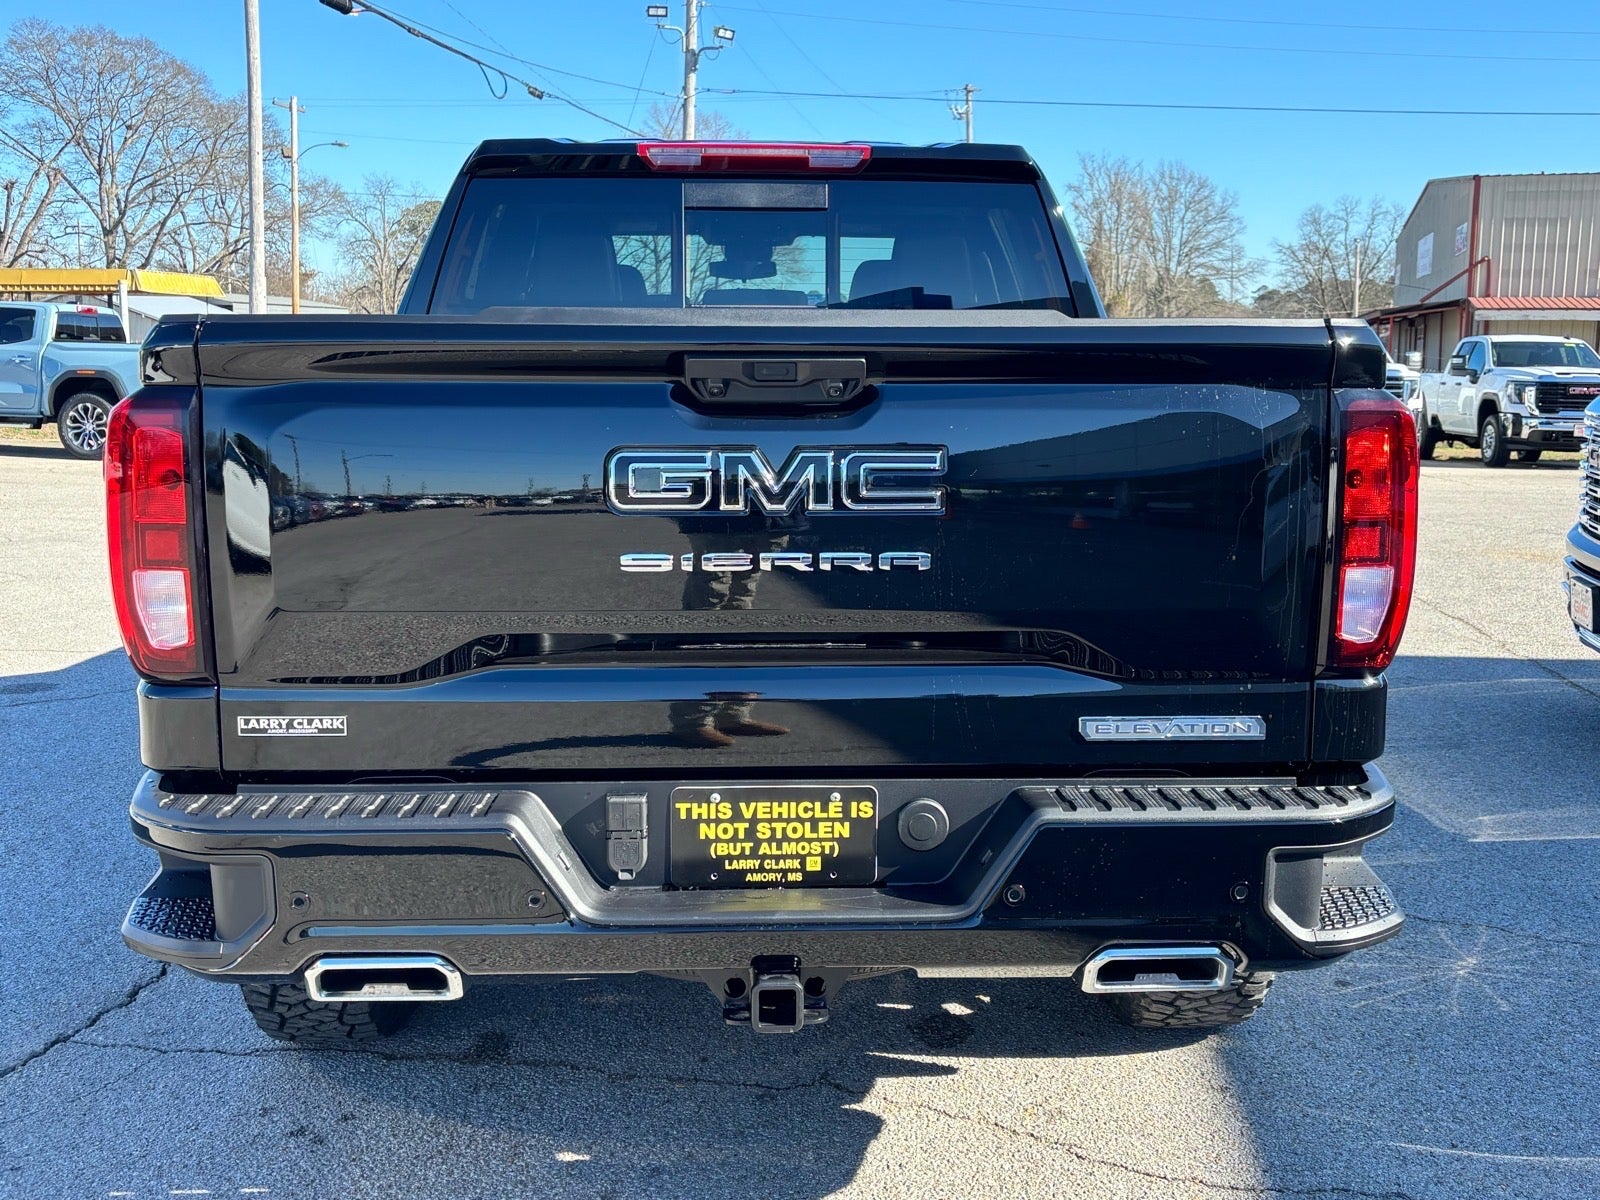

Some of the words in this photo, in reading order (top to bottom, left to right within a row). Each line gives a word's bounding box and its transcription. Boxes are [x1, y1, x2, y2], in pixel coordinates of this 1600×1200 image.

[606, 447, 947, 513] GMC
[620, 552, 932, 573] SIERRA
[240, 719, 290, 729] LARRY
[293, 719, 345, 729] CLARK
[1094, 722, 1251, 734] ELEVATION
[675, 802, 733, 820] THIS
[739, 801, 843, 819] VEHICLE
[850, 801, 874, 818] IS
[699, 822, 750, 840] NOT
[756, 821, 850, 839] STOLEN
[710, 842, 753, 859] (BUT
[758, 841, 840, 858] ALMOST)
[724, 859, 761, 870] LARRY
[763, 859, 801, 870] CLARK
[745, 872, 786, 883] AMORY,
[787, 872, 803, 882] MS
